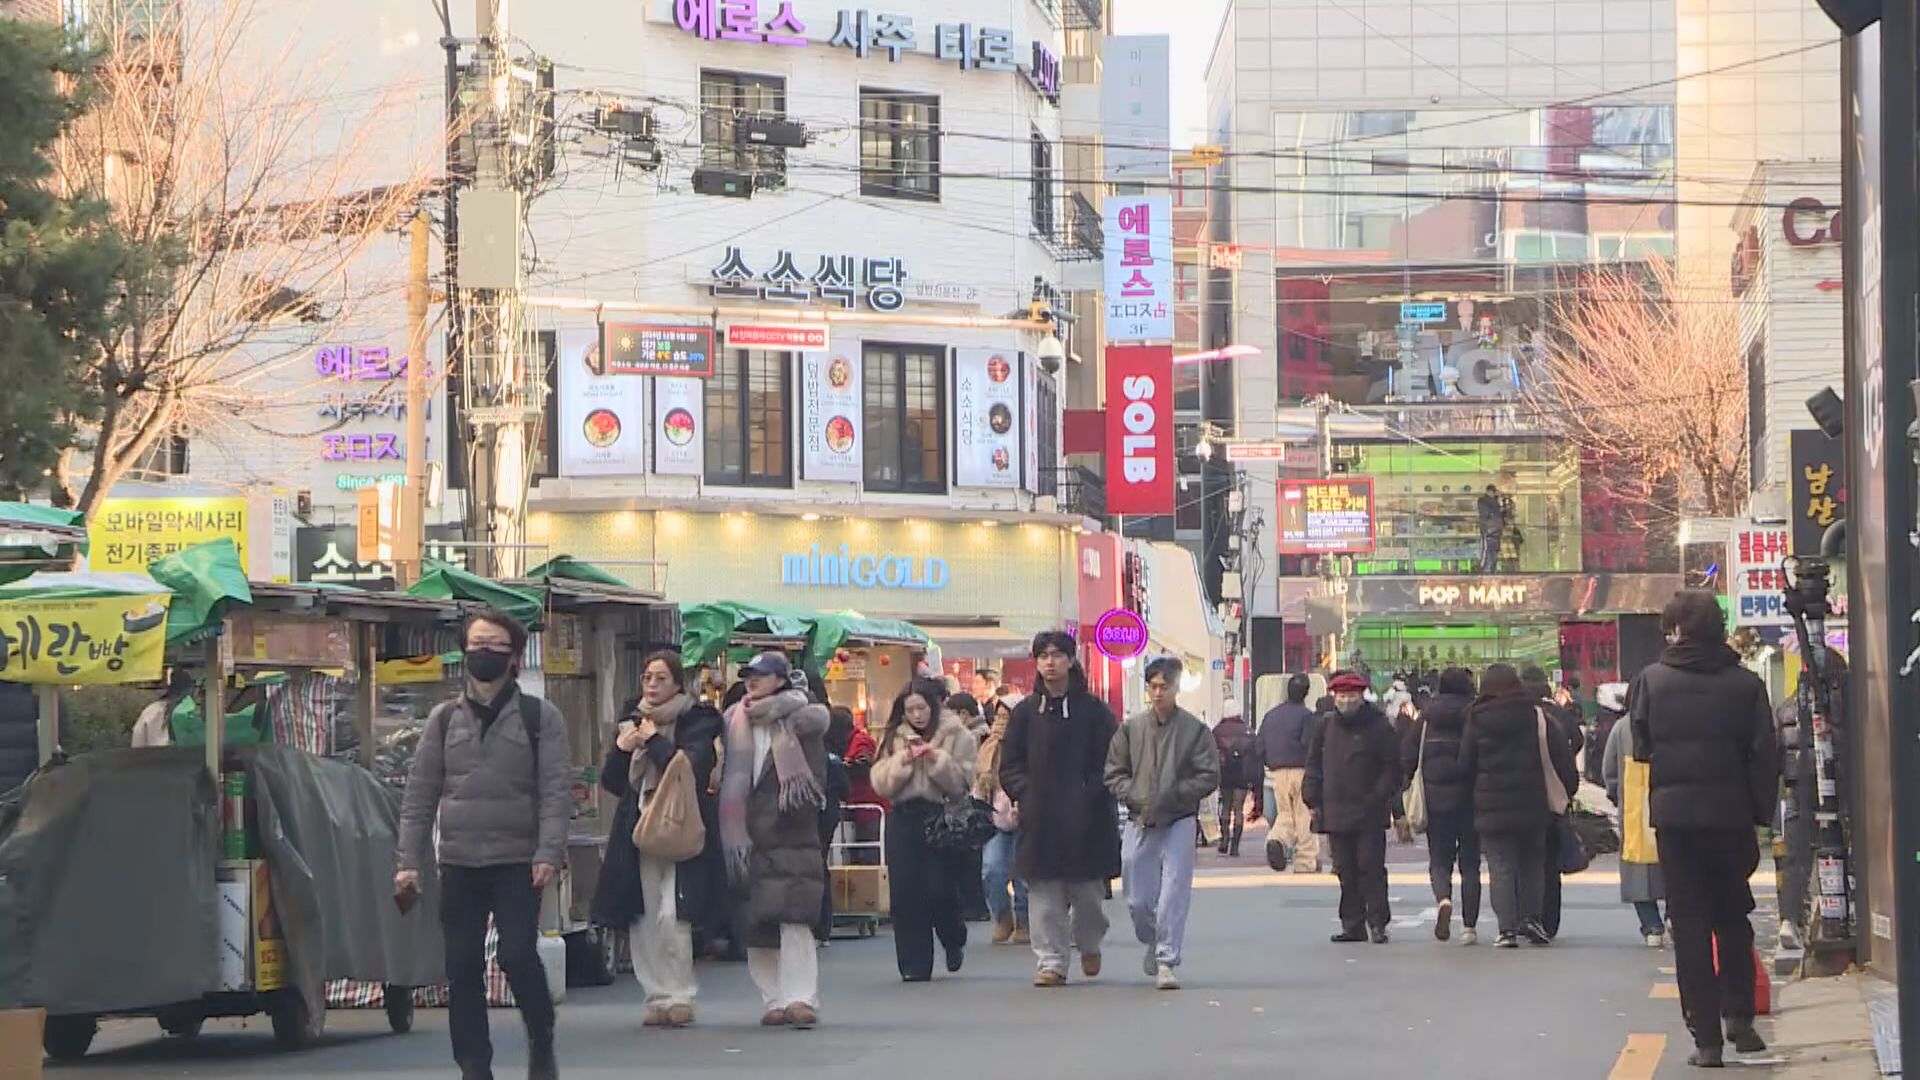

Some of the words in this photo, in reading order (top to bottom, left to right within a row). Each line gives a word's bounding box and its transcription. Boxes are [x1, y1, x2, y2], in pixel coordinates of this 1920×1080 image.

[672, 0, 809, 48] 에로스
[826, 8, 917, 63] 사주
[935, 22, 1019, 70] 타로
[1118, 203, 1155, 297] 에로스
[709, 245, 908, 313] 소소식당
[1129, 323, 1149, 335] 3F
[318, 393, 432, 421] 사주카
[961, 375, 974, 448] 소소식당
[1123, 375, 1156, 483] SOLB
[336, 475, 376, 489] Since
[105, 511, 242, 532] 모바일악세사리
[782, 545, 949, 589] miniGOLD
[1419, 585, 1461, 604] POP
[1468, 585, 1527, 604] MART
[1741, 595, 1793, 617] 폰케이
[1102, 626, 1140, 644] SOLB
